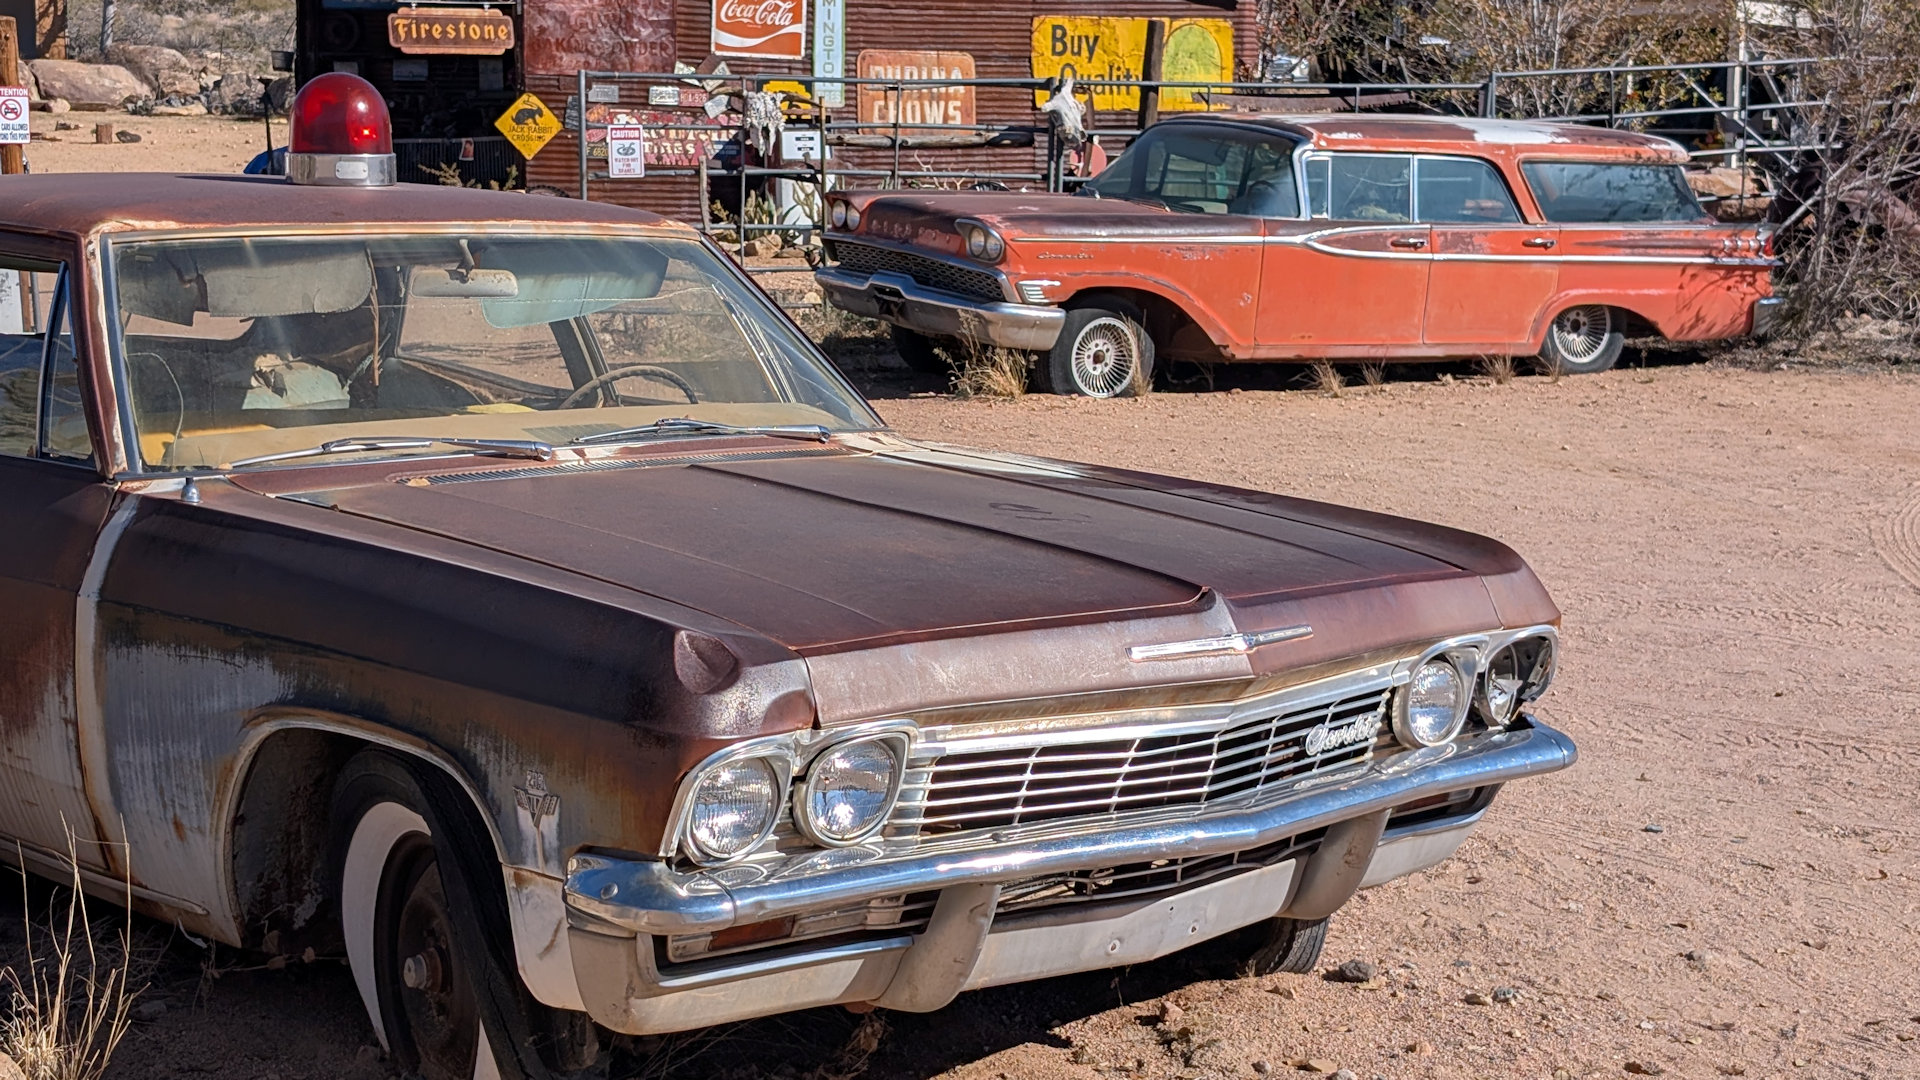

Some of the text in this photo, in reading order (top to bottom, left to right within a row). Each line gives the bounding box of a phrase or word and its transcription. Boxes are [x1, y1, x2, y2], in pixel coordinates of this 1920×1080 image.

[394, 18, 509, 42] Firestone
[1051, 24, 1100, 63] Buy
[872, 99, 962, 125] CHOWS
[527, 126, 552, 134] RABBIT
[611, 129, 640, 139] CAUTION
